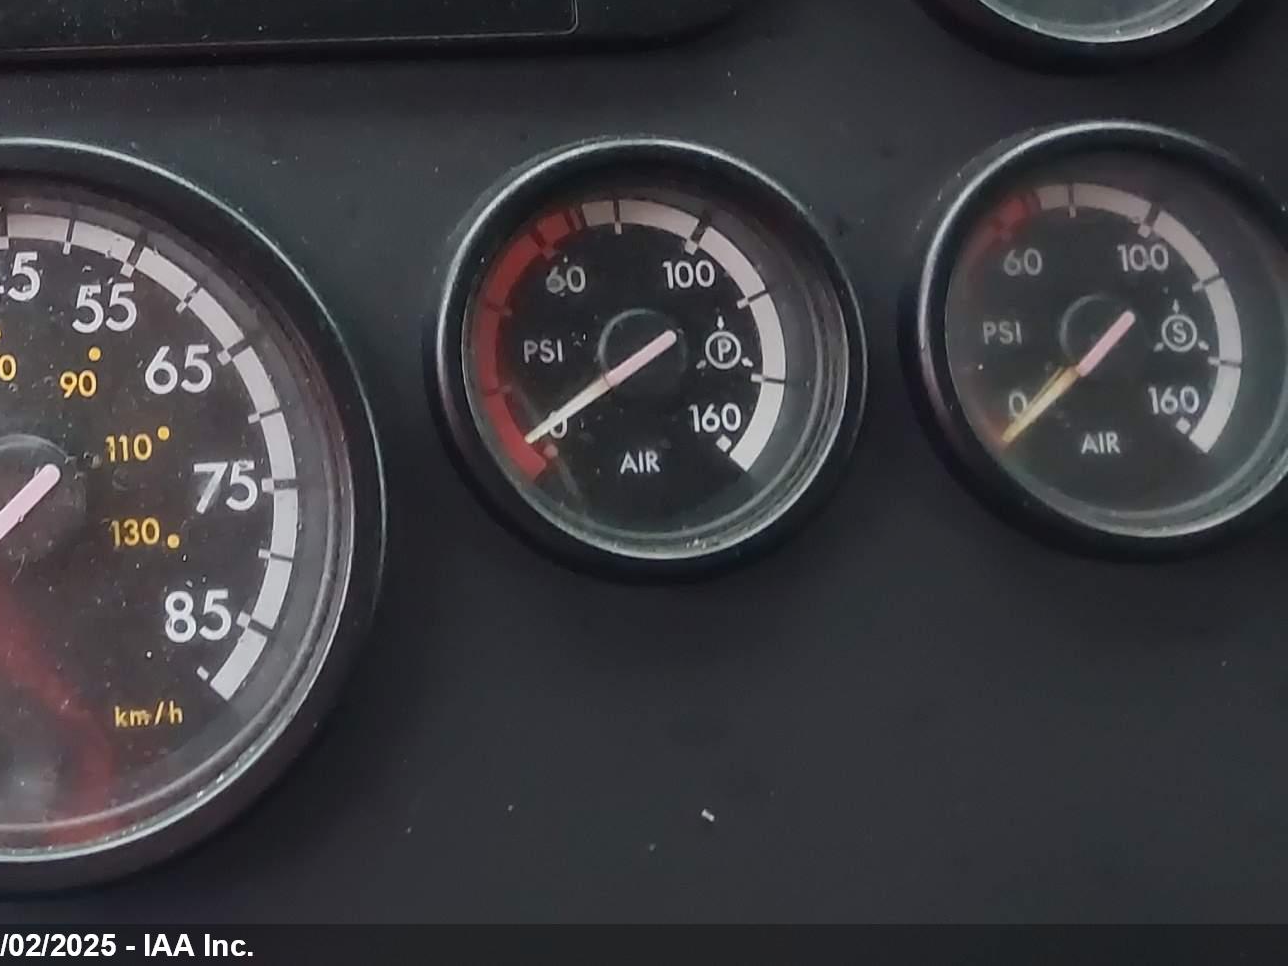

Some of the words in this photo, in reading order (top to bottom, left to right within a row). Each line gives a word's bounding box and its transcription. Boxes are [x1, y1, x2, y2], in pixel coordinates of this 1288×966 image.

[1003, 248, 1043, 276] 60
[1117, 244, 1169, 272] 100
[545, 265, 586, 294] 60
[662, 259, 715, 290] 100
[72, 282, 138, 334] 55
[983, 321, 1022, 345] PSI
[523, 340, 563, 363] PSI
[59, 371, 97, 398] 90
[144, 345, 213, 396] 65
[1148, 386, 1201, 415] 160
[688, 403, 742, 433] 160
[105, 435, 152, 463] 110
[1081, 432, 1121, 455] AIR
[620, 451, 661, 474] AIR
[193, 460, 258, 513] 75
[110, 519, 160, 547] 130
[164, 590, 231, 644] 85
[114, 703, 183, 728] km/h
